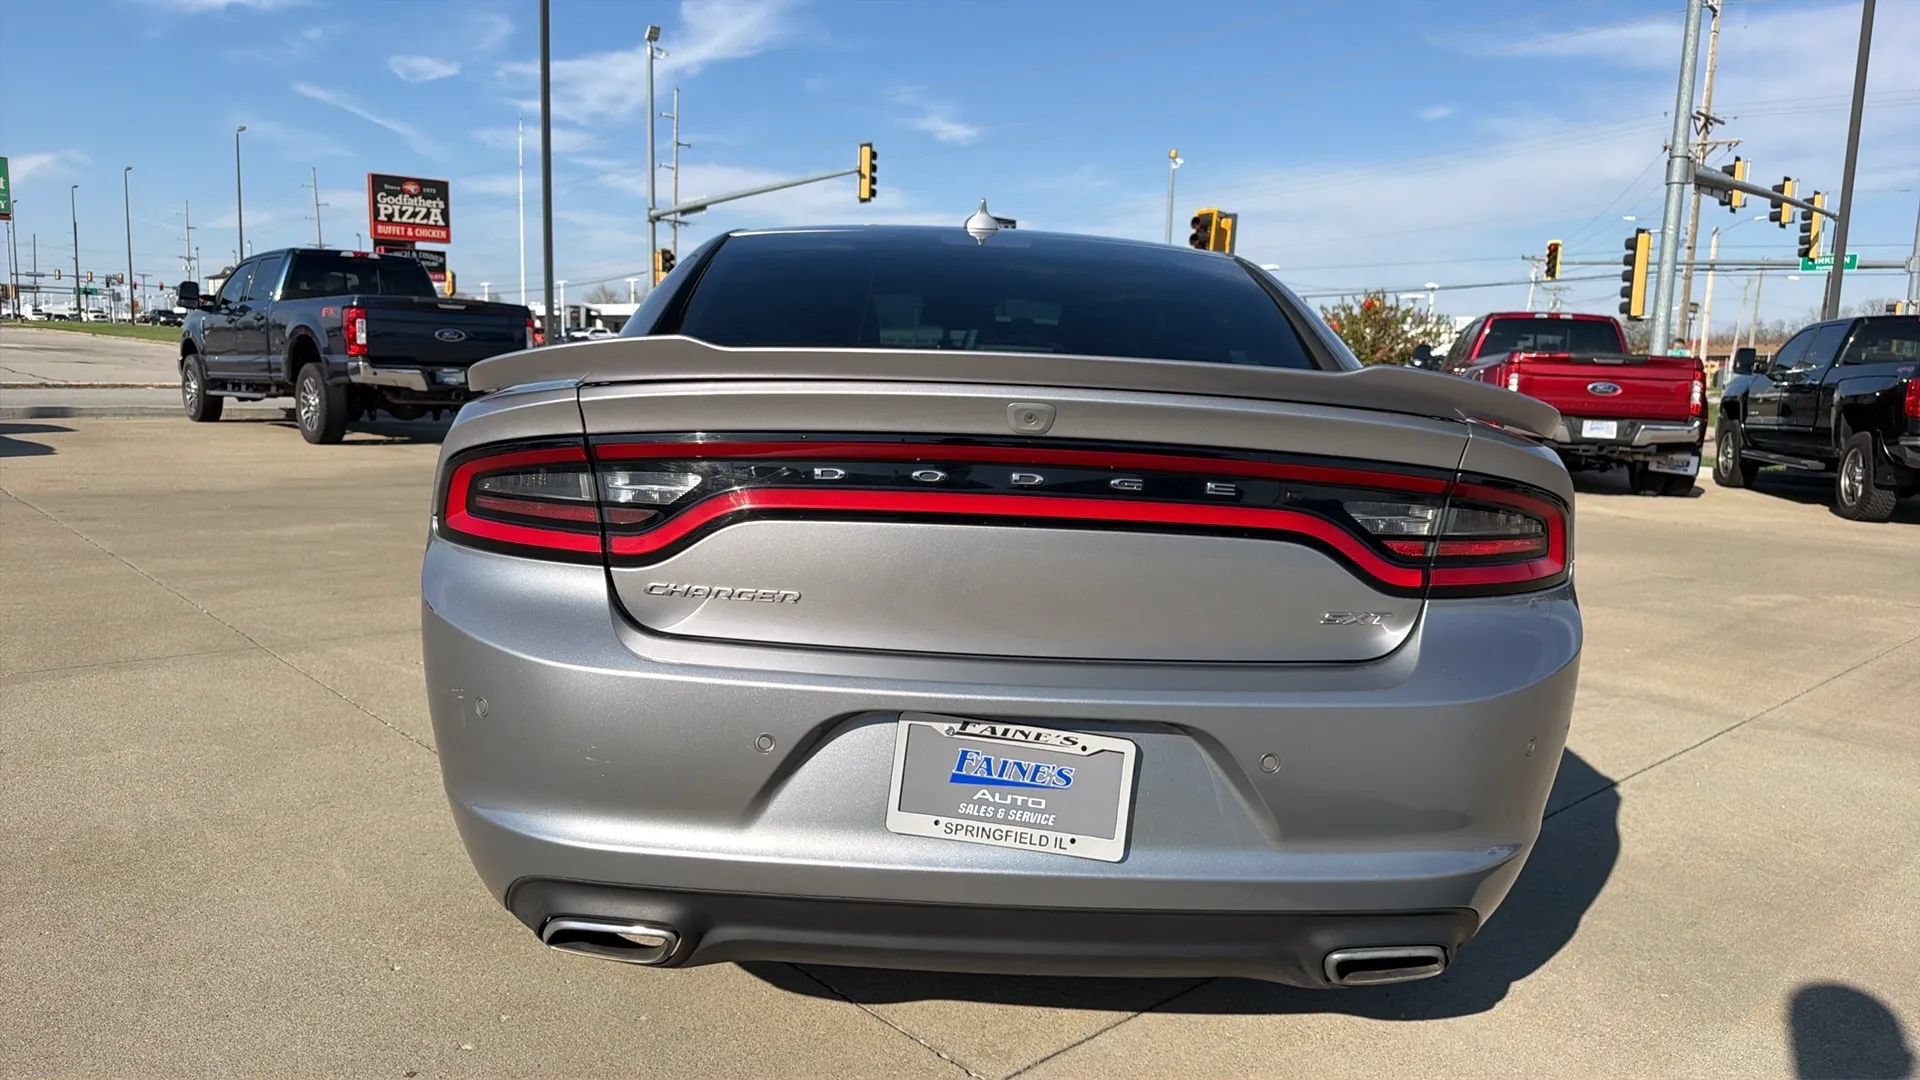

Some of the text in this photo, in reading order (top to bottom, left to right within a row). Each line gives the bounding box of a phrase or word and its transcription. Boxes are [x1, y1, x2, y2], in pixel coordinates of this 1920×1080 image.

[377, 191, 445, 209] Godfather's
[377, 203, 445, 226] PIZZA
[377, 225, 446, 239] BUFFET & CHICKEN
[814, 467, 1236, 496] DODGE
[644, 582, 802, 604] CHARGER
[1320, 611, 1393, 625] SXT
[957, 720, 1079, 746] FAINE'S
[952, 748, 1076, 788] FAINE'S
[973, 789, 1046, 809] AUTO
[958, 802, 1056, 826] SALES & SERVICE
[944, 822, 1068, 850] SPRINGFIELD IL
